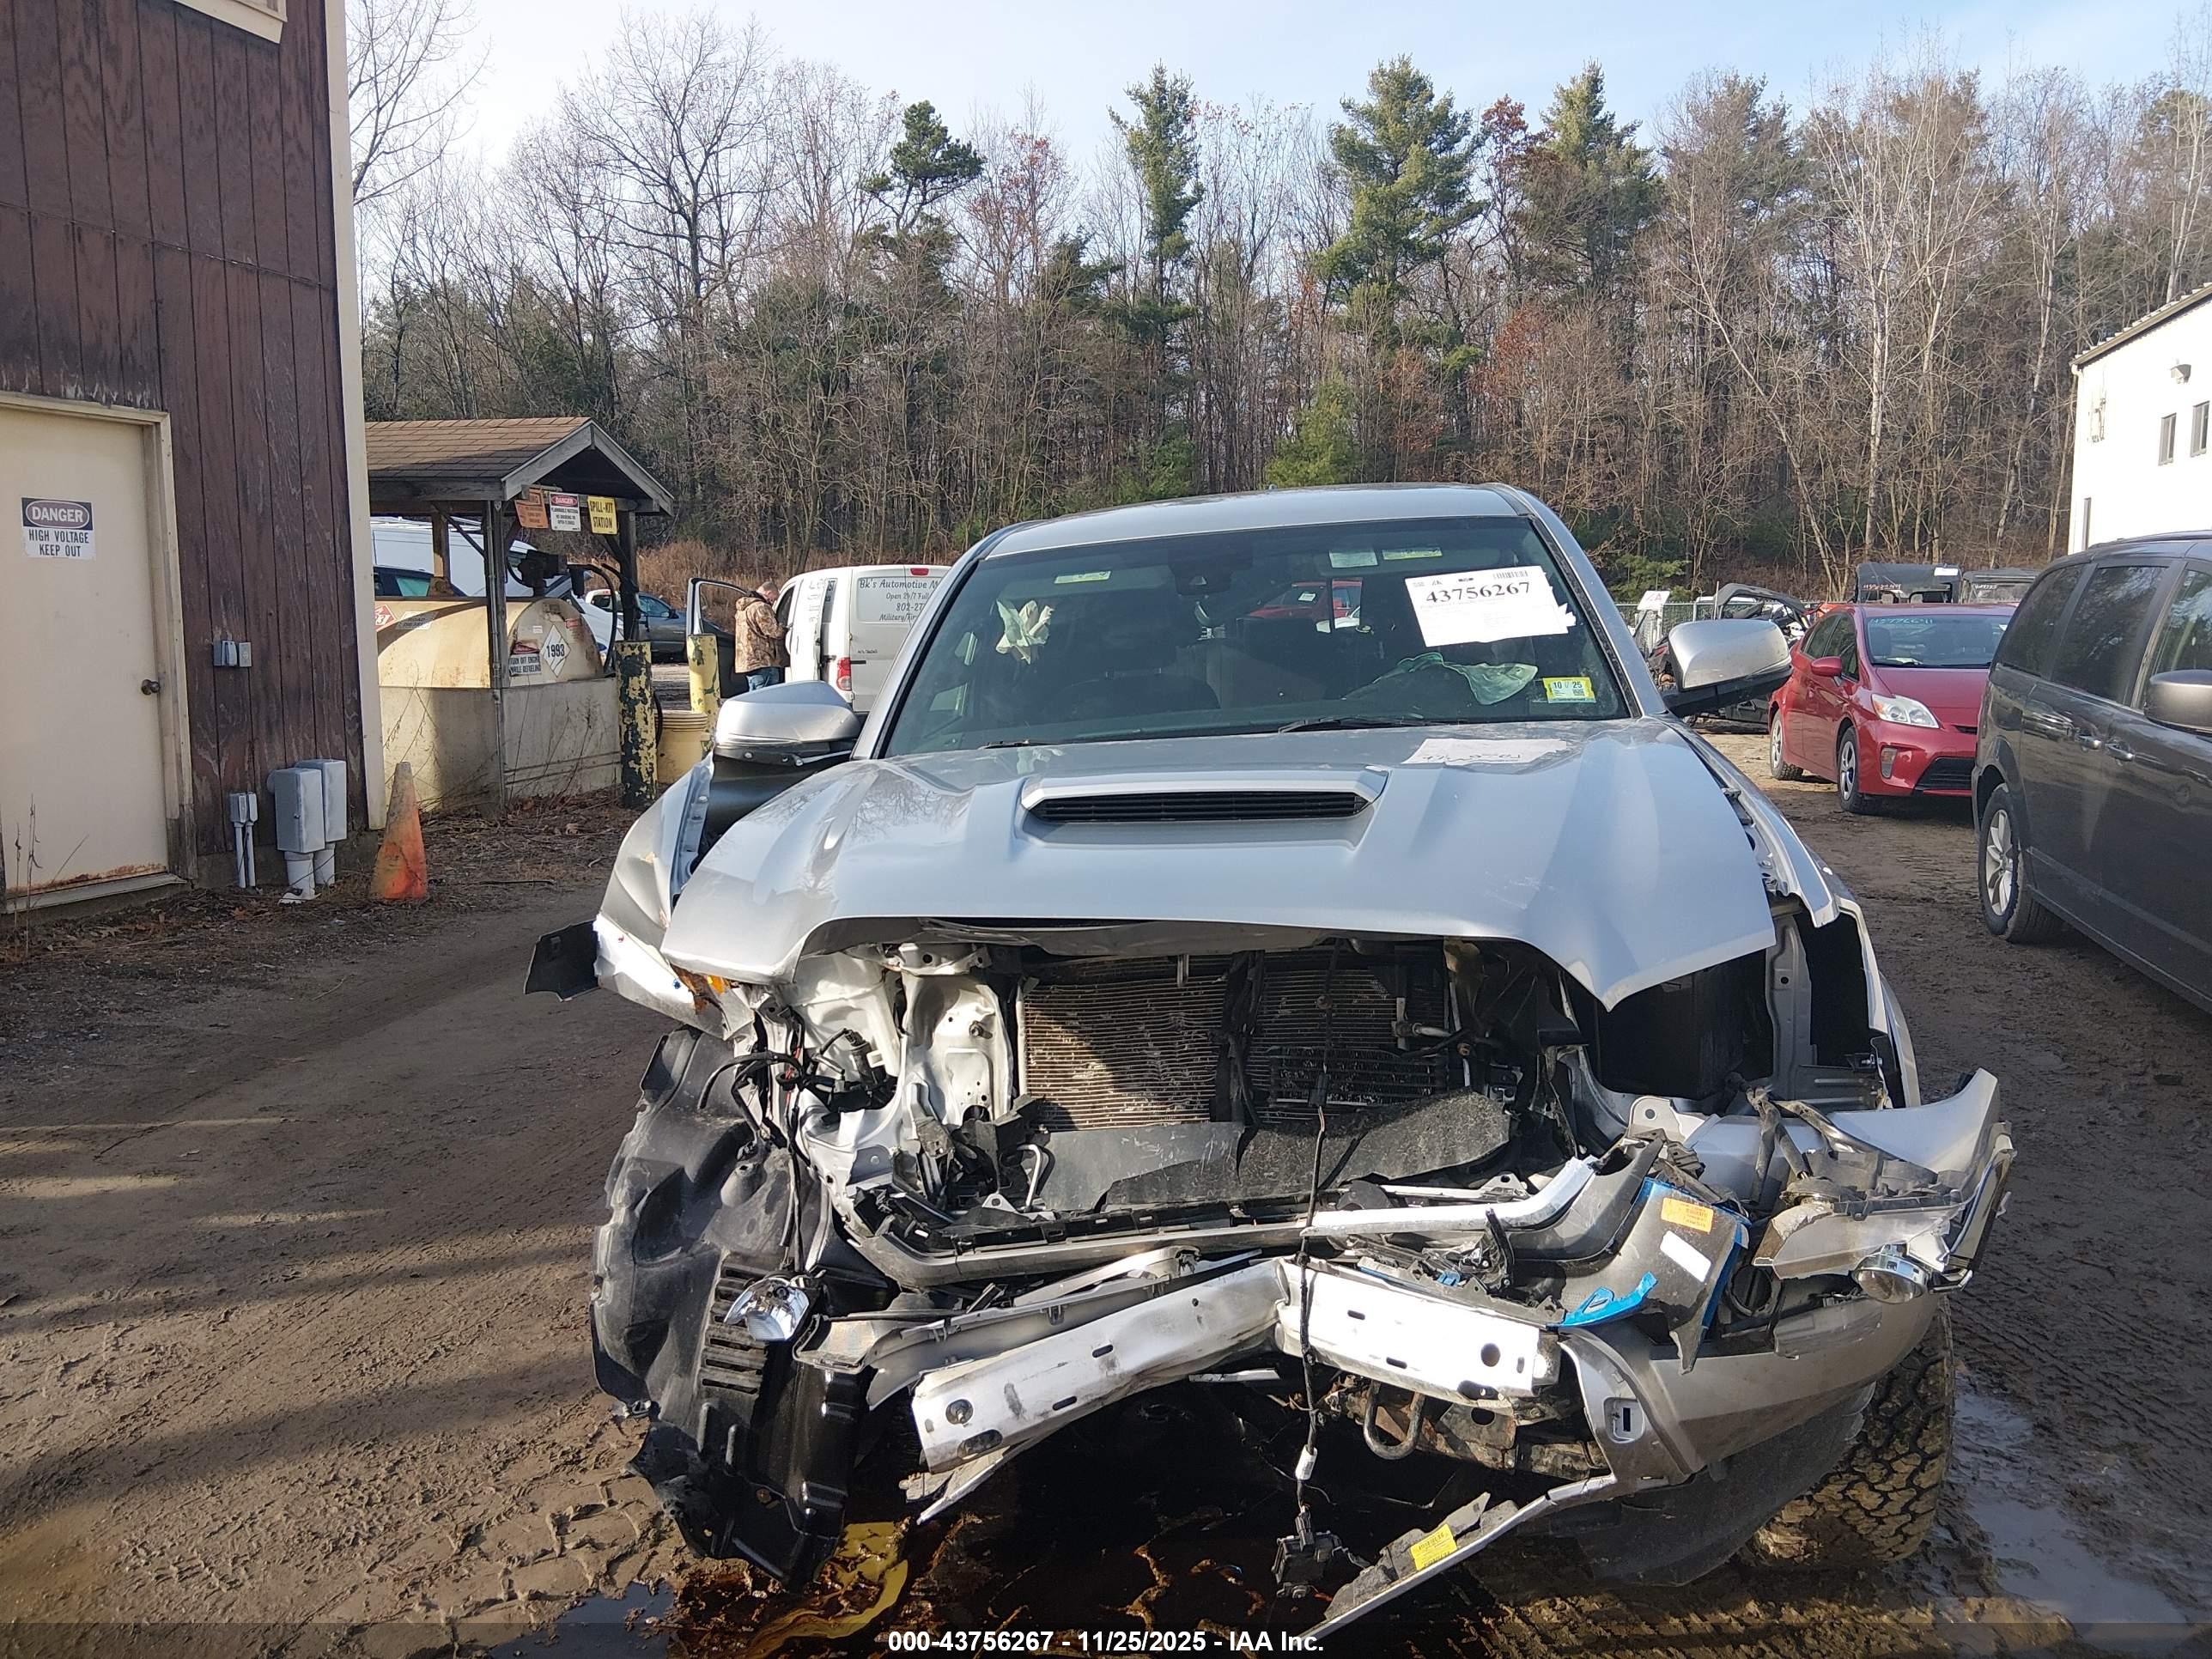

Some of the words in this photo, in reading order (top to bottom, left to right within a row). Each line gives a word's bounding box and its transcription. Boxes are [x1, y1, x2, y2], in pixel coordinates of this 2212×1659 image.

[589, 501, 614, 514] SPILL-KIT
[32, 506, 83, 523] DANGER
[592, 516, 613, 529] STATION
[28, 529, 50, 542] HIGH
[54, 531, 89, 544] VOLTAGE
[39, 544, 61, 556] KEEP
[64, 544, 82, 557] OUT
[860, 578, 878, 589] Bk's
[879, 579, 927, 590] Automotive
[886, 592, 902, 601] Open
[1425, 581, 1530, 604] 43756267
[546, 643, 565, 658] 1993
[1553, 681, 1563, 690] 10
